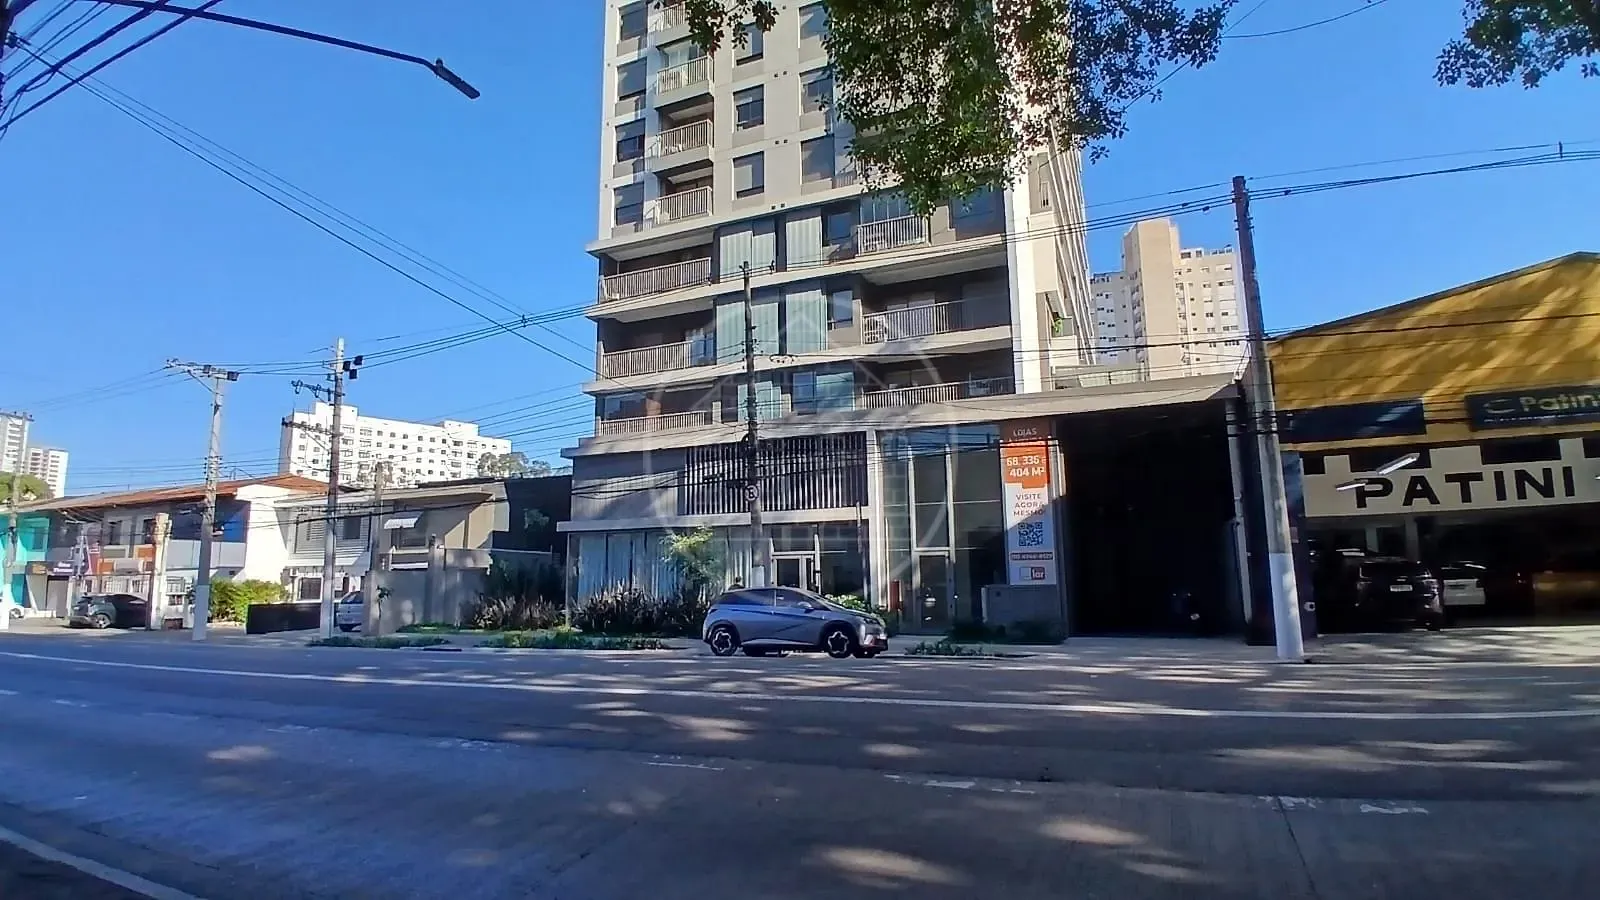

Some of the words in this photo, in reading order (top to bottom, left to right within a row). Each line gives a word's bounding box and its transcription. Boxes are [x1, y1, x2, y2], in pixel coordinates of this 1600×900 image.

[1519, 393, 1600, 411] Patin
[1009, 467, 1030, 478] 404
[1354, 466, 1576, 509] PATINI
[1013, 509, 1044, 517] MESMO
